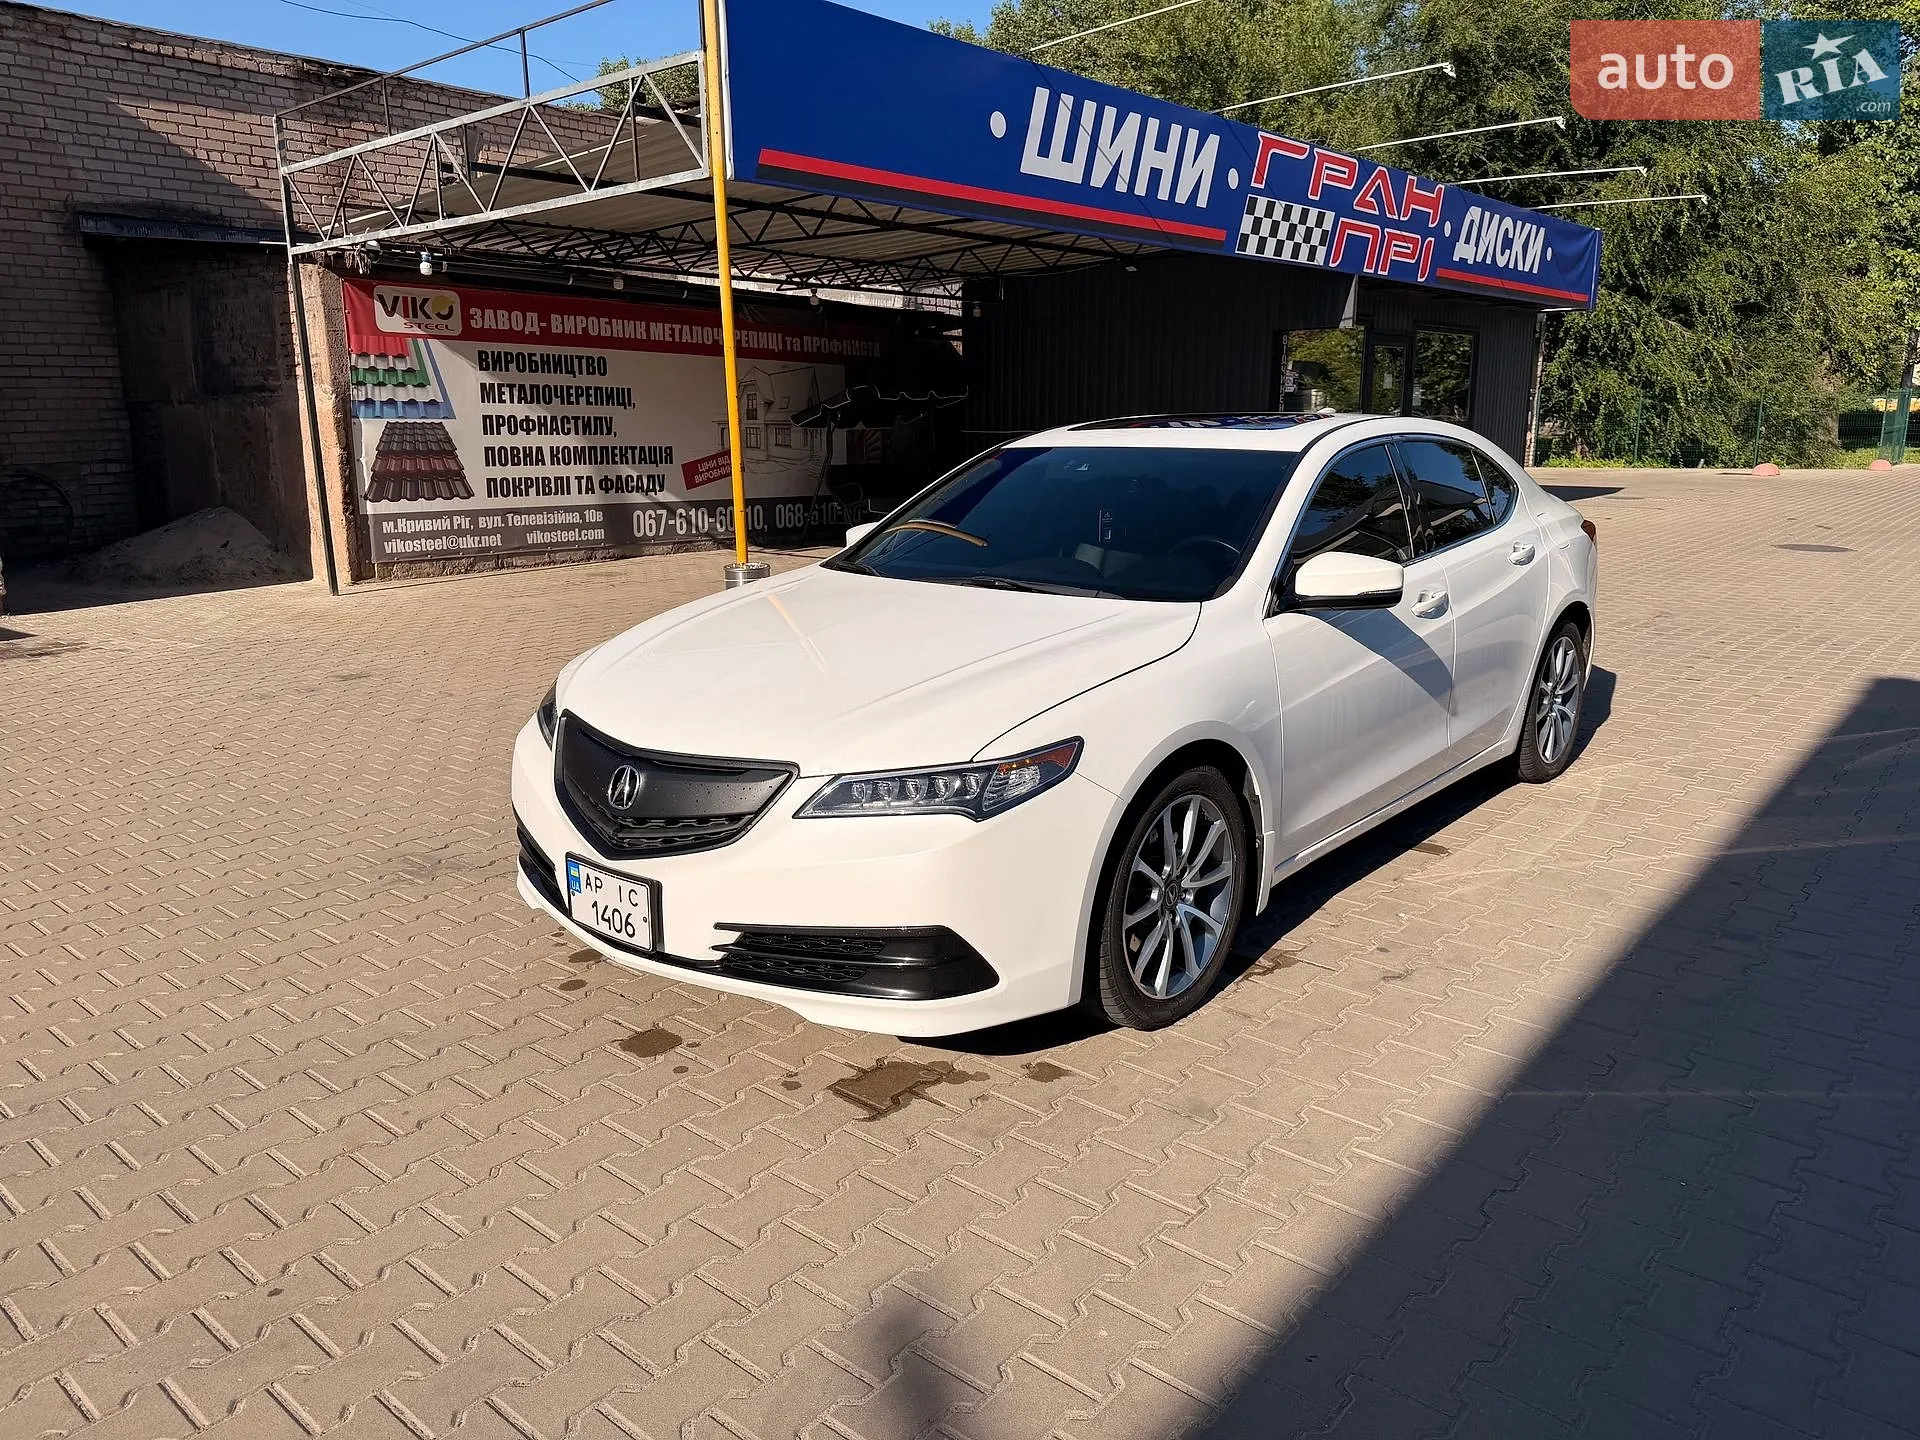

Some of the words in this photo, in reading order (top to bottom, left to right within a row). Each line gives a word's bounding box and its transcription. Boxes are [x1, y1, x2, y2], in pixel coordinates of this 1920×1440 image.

[1020, 86, 1220, 208] ШИНИ
[1250, 131, 1444, 228] ГРАН
[1329, 217, 1436, 283] ПРІ
[1453, 205, 1548, 275] ДИСКИ
[376, 292, 455, 320] VIKO
[403, 321, 455, 332] STEEL
[469, 307, 547, 336] ЗАВОД-
[551, 313, 647, 340] ВИРОБНИК
[650, 321, 783, 352] МЕТАЛОЧРЕПИЦІ
[784, 336, 801, 352] та
[477, 349, 608, 378] ВИРОБНИЦТВО
[479, 381, 636, 410] МЕТАЛОЧЕРЕПИЦІ,
[481, 414, 617, 438] ПРОФНАСТИЛУ,
[483, 445, 546, 467] ПОВНА
[549, 445, 674, 468] КОМПЛЕКТАЦІЯ
[698, 459, 717, 472] ЦІНИ
[717, 455, 731, 466] ВІД
[486, 475, 571, 499] ПОКРІВЛІ
[575, 475, 596, 495] ТА
[598, 473, 666, 496] ФАСАДУ
[694, 466, 732, 483] ВИРОБНИК
[453, 515, 474, 531] Ріг,
[478, 515, 505, 529] вул.
[506, 509, 583, 527] Телевізійна,
[583, 509, 604, 522] 10в
[632, 503, 769, 538] 067-610-6010,
[384, 532, 503, 554] vikosteel@ukr.net
[526, 528, 605, 544] vikosteel.com
[585, 872, 603, 894] AP
[618, 884, 639, 908] IC
[592, 900, 636, 938] 1406
